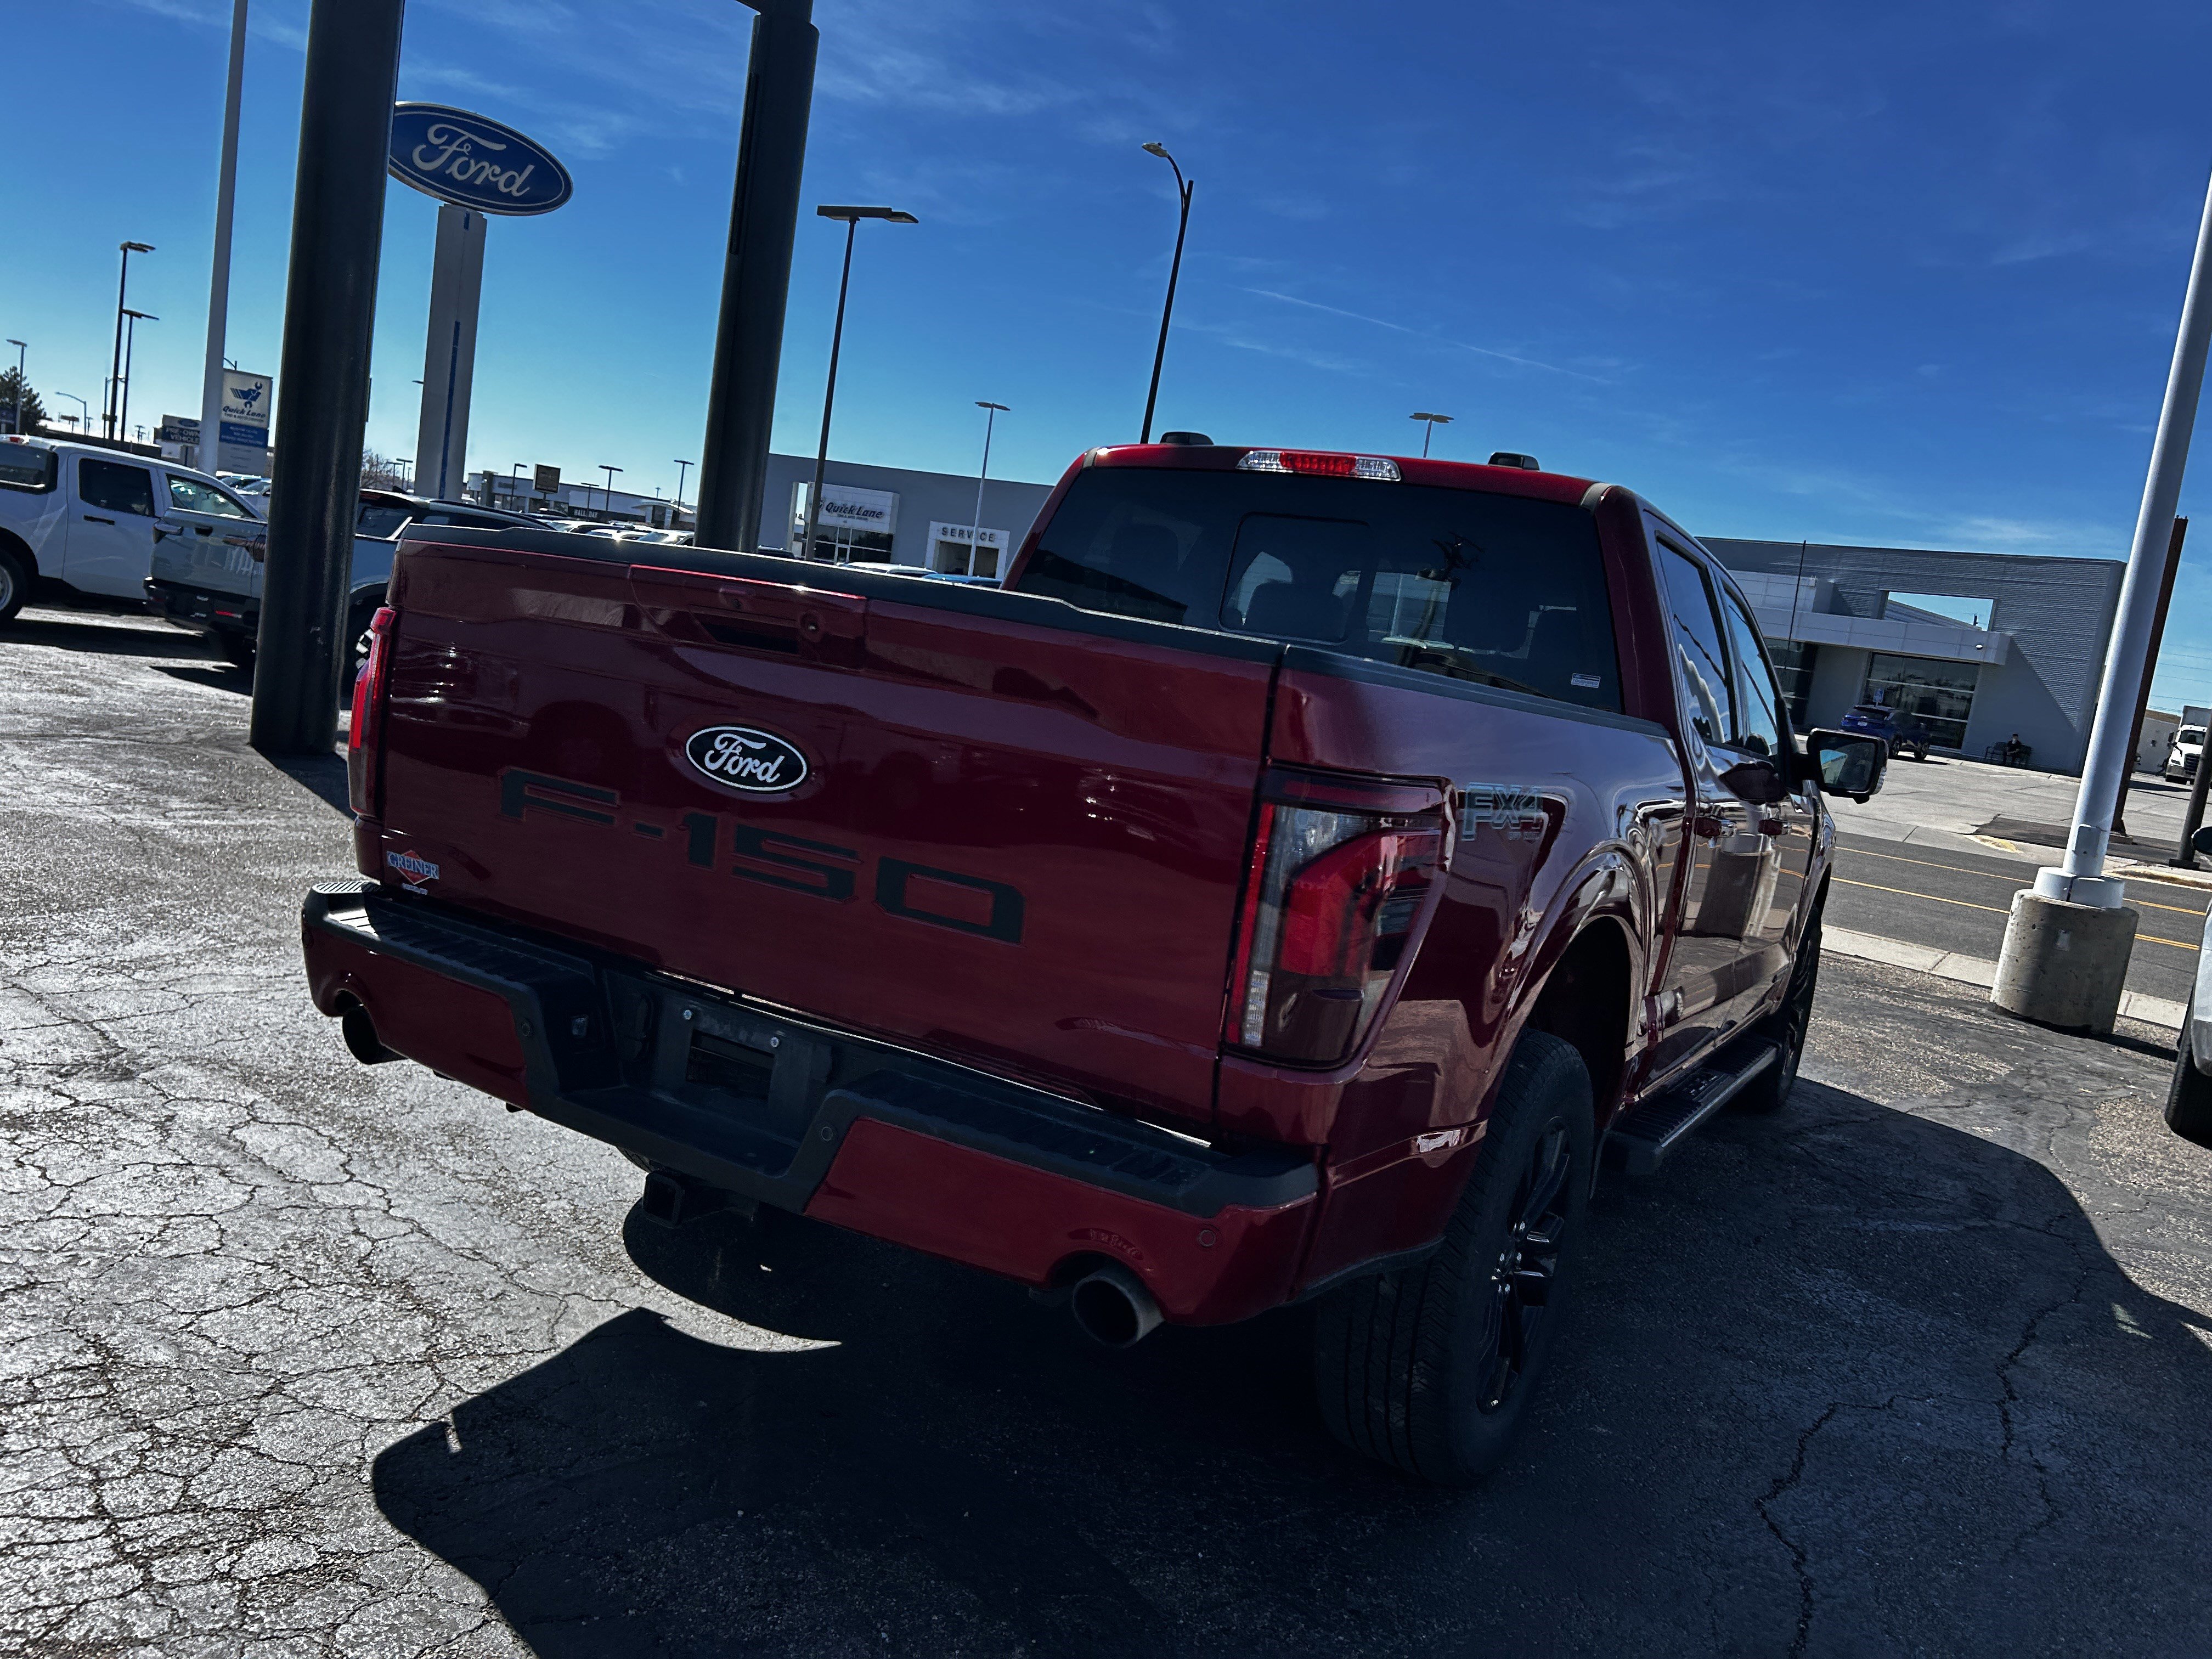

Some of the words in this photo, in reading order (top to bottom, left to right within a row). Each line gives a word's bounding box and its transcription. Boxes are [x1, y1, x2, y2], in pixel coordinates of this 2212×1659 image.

[412, 123, 534, 197] Ford
[223, 406, 246, 414] Quick
[166, 427, 200, 437] PRE-OWN
[171, 435, 200, 445] VEHICLE
[574, 509, 598, 518] HALLDAY
[826, 502, 855, 515] Quick
[856, 506, 882, 518] Lane
[941, 527, 995, 542] SERVCE
[704, 733, 785, 783] Ford
[1462, 782, 1543, 840] FX4
[499, 768, 1025, 945] F-150
[387, 853, 439, 880] GREINER
